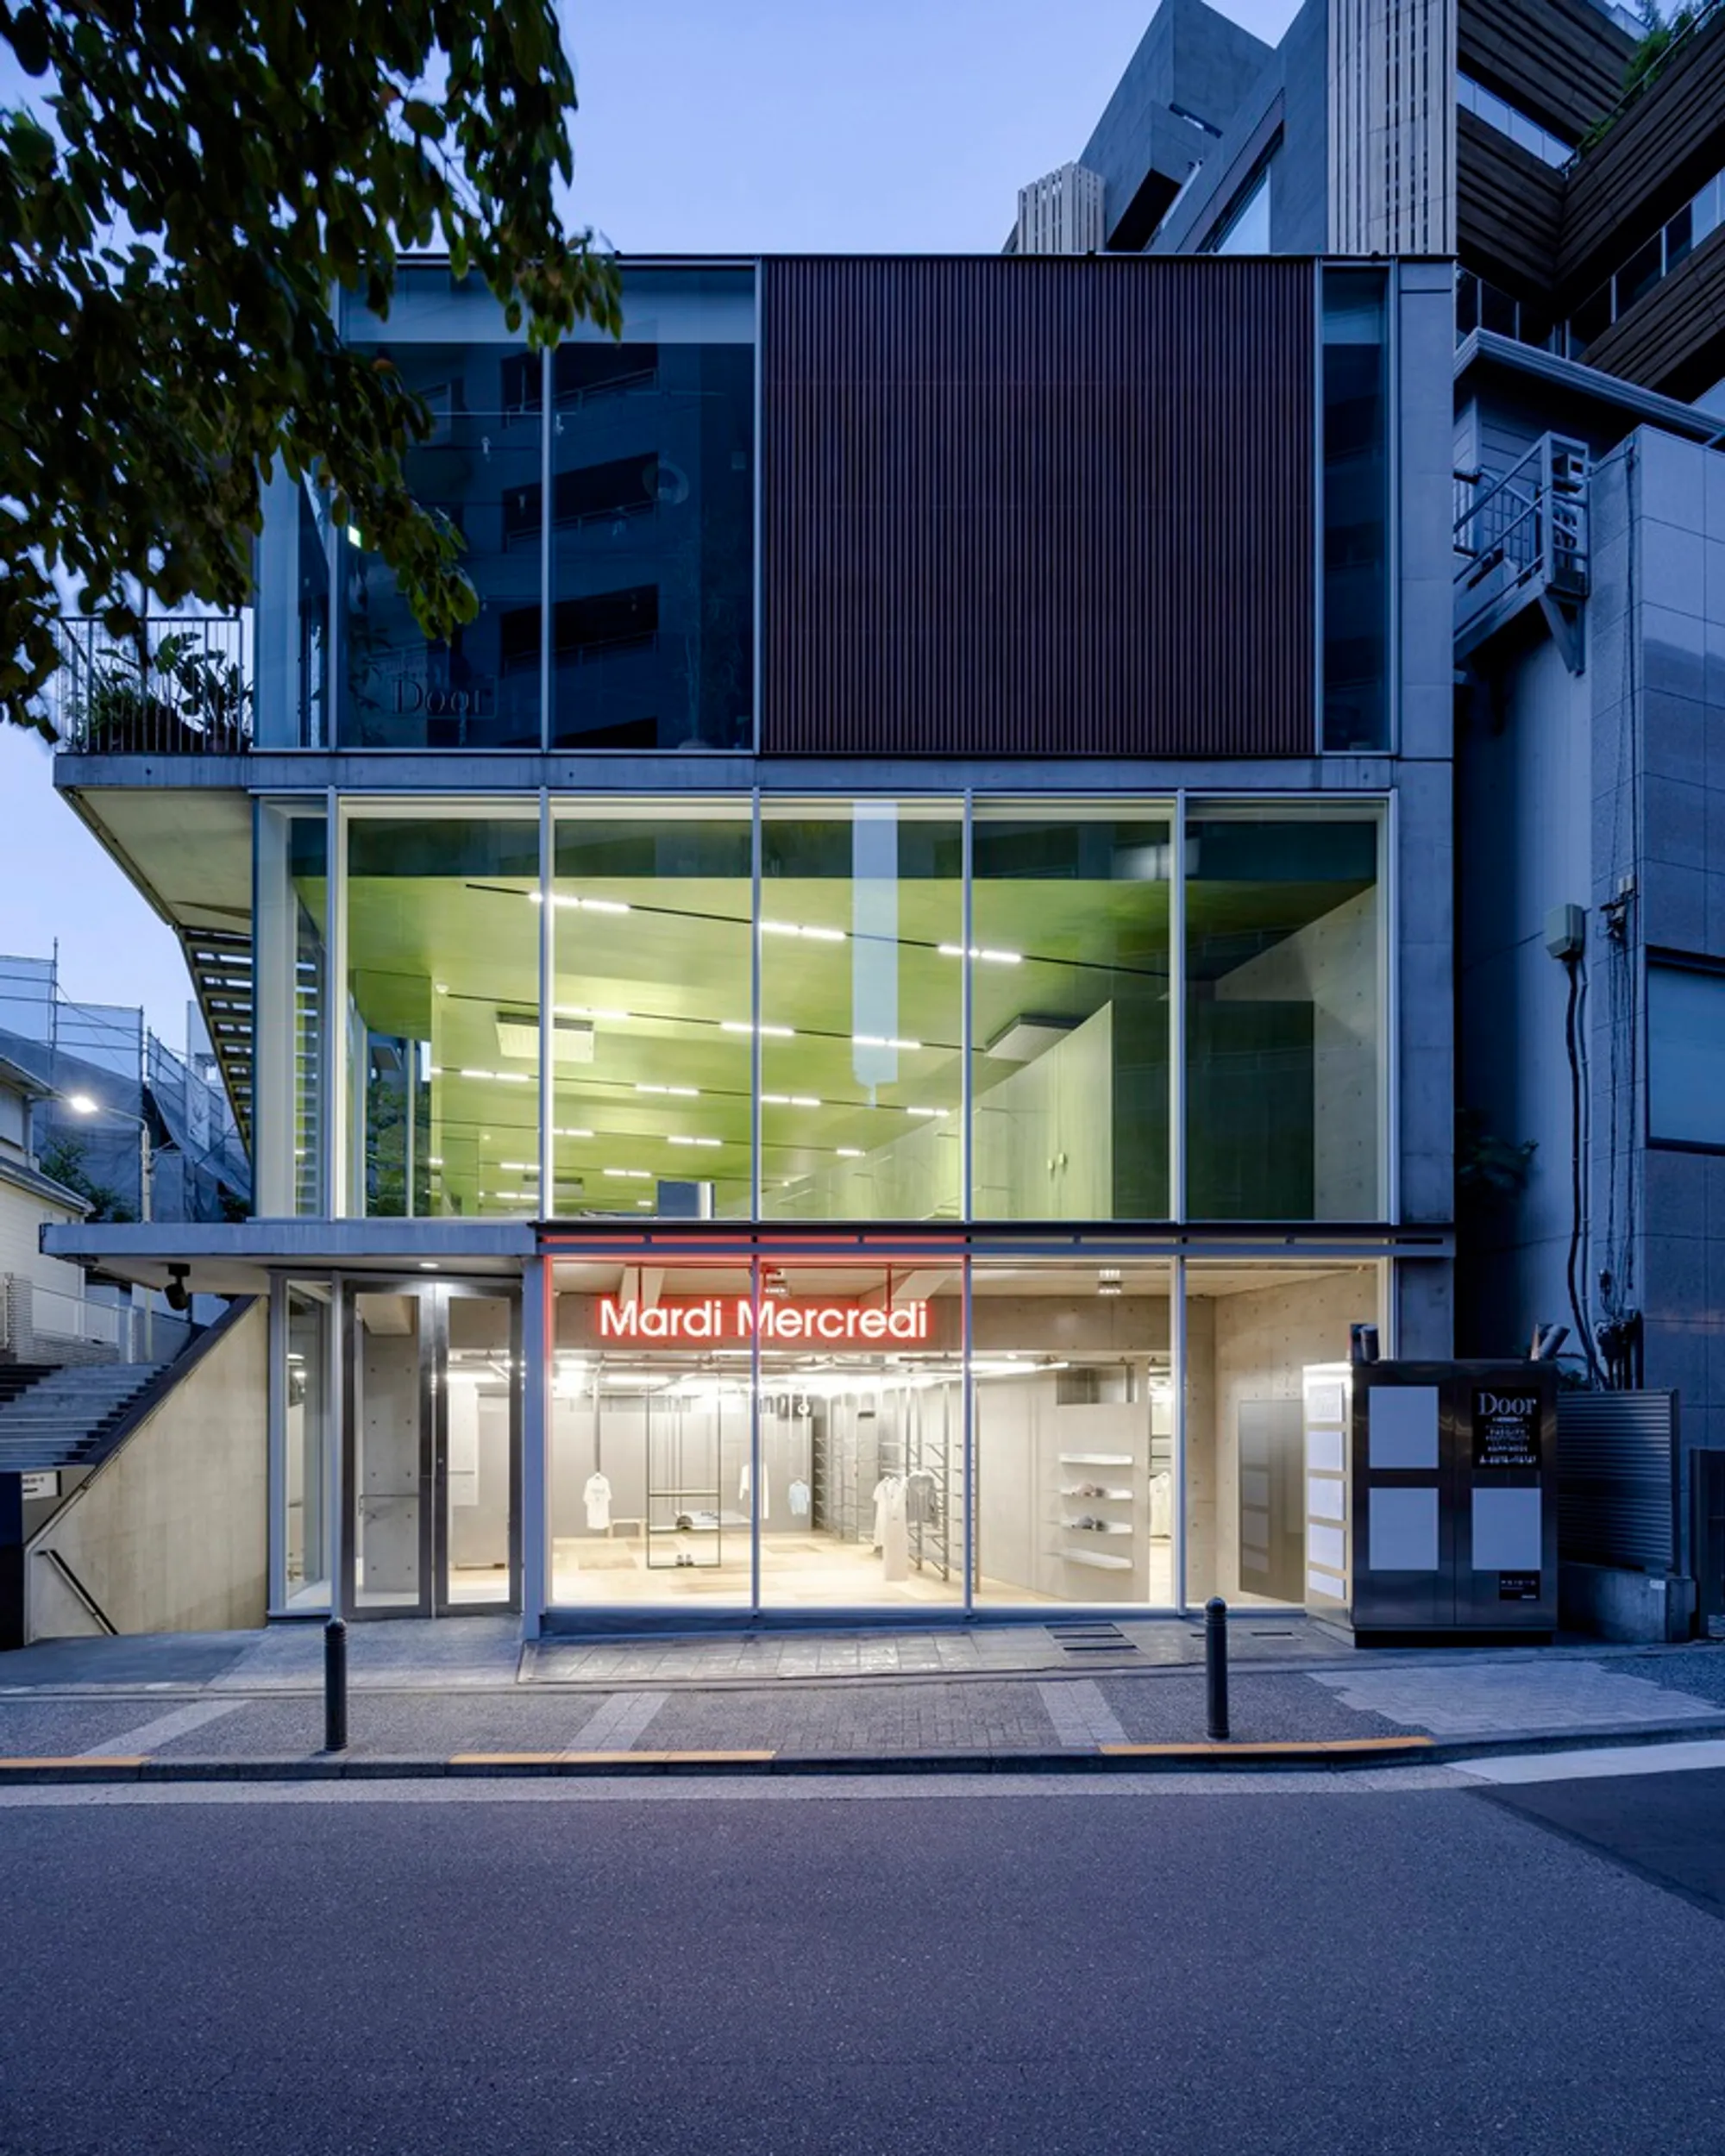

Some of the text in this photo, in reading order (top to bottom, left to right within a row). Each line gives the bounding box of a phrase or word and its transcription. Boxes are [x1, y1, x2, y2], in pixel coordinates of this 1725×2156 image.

[392, 679, 492, 714] Door
[599, 1299, 927, 1339] Mardi Mercredi
[1478, 1392, 1537, 1415] Door
